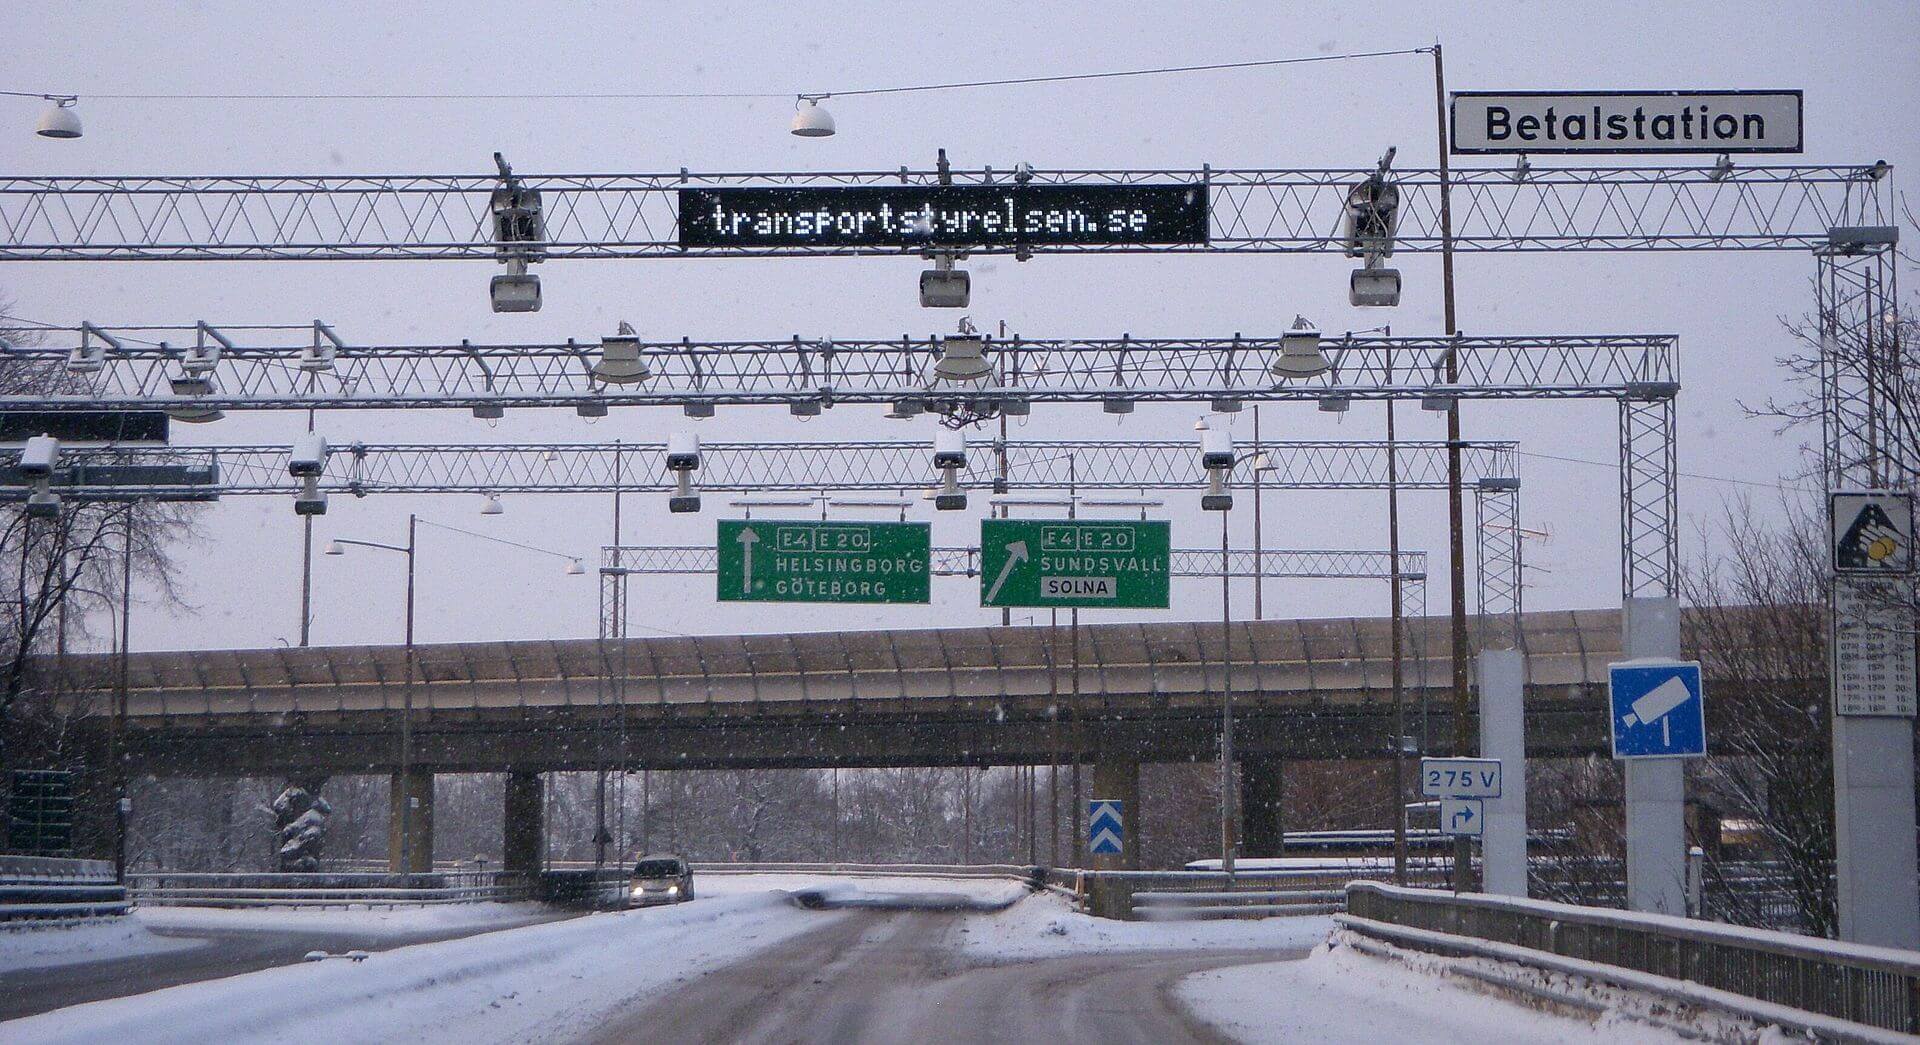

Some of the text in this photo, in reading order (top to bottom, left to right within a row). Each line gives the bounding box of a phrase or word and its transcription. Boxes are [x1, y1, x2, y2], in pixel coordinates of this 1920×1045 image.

[1486, 105, 1765, 141] Betalstation
[712, 198, 1148, 234] transportstyrelsen.se
[784, 532, 808, 547] E4
[1047, 532, 1072, 545] E4
[775, 558, 923, 574] HELSINGBORG
[1041, 557, 1162, 571] SUNDSVALL
[776, 577, 886, 595] GÖTEBORG
[1049, 581, 1108, 594] SOLNA
[1428, 769, 1495, 787] 275 V
